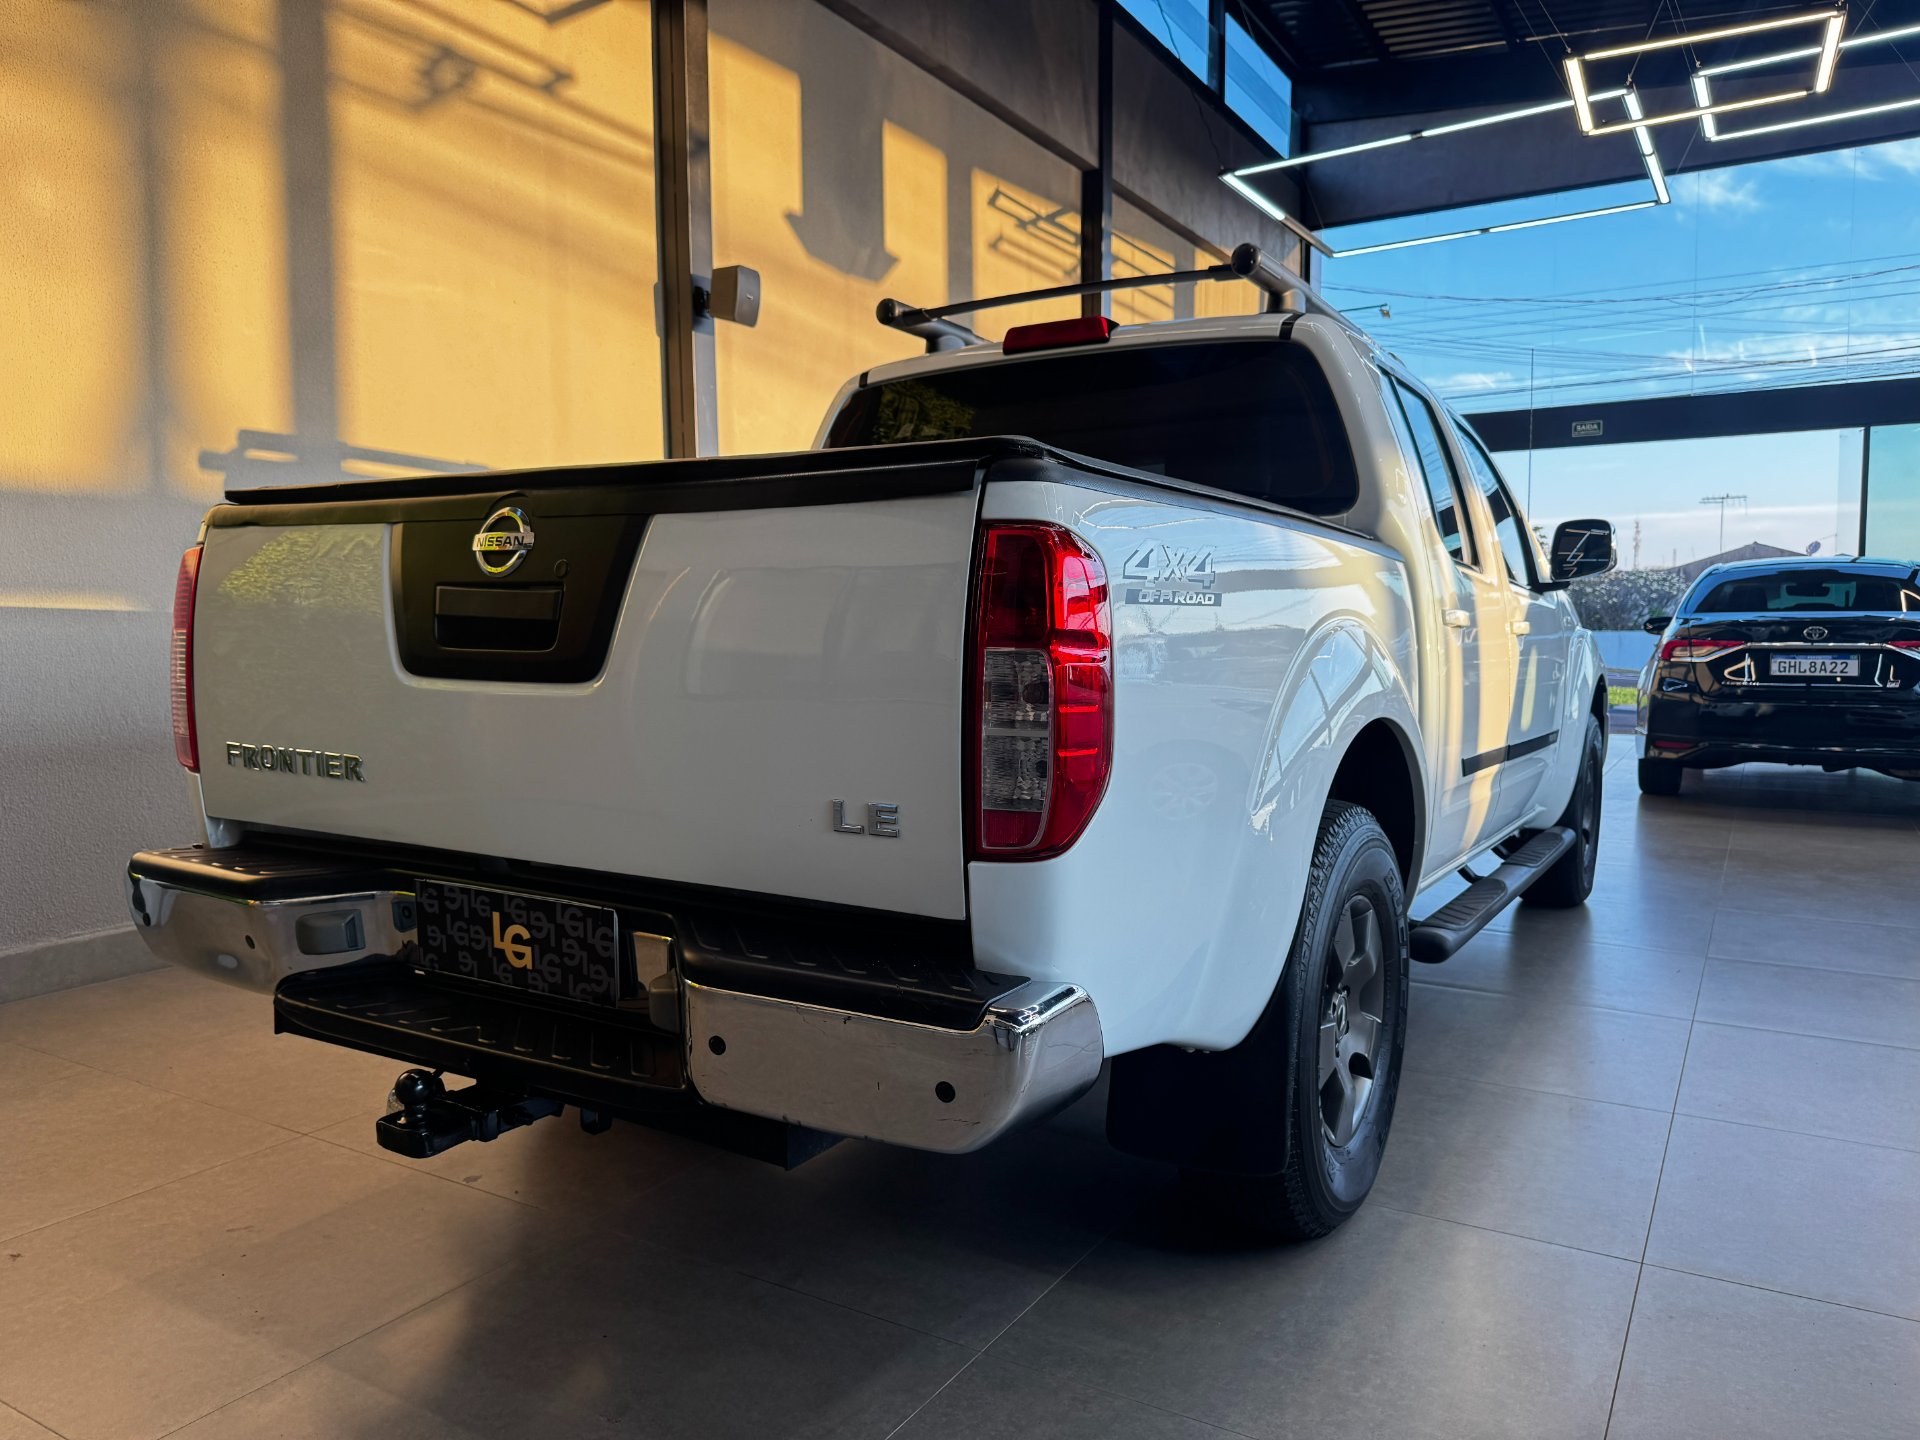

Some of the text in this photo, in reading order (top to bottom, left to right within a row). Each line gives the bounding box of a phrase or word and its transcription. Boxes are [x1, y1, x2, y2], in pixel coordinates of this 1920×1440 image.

[476, 535, 525, 548] NISSAN
[1777, 661, 1849, 674] GHL8A22
[226, 741, 366, 782] FRONTIER
[832, 798, 899, 838] LE
[492, 911, 533, 970] LG
